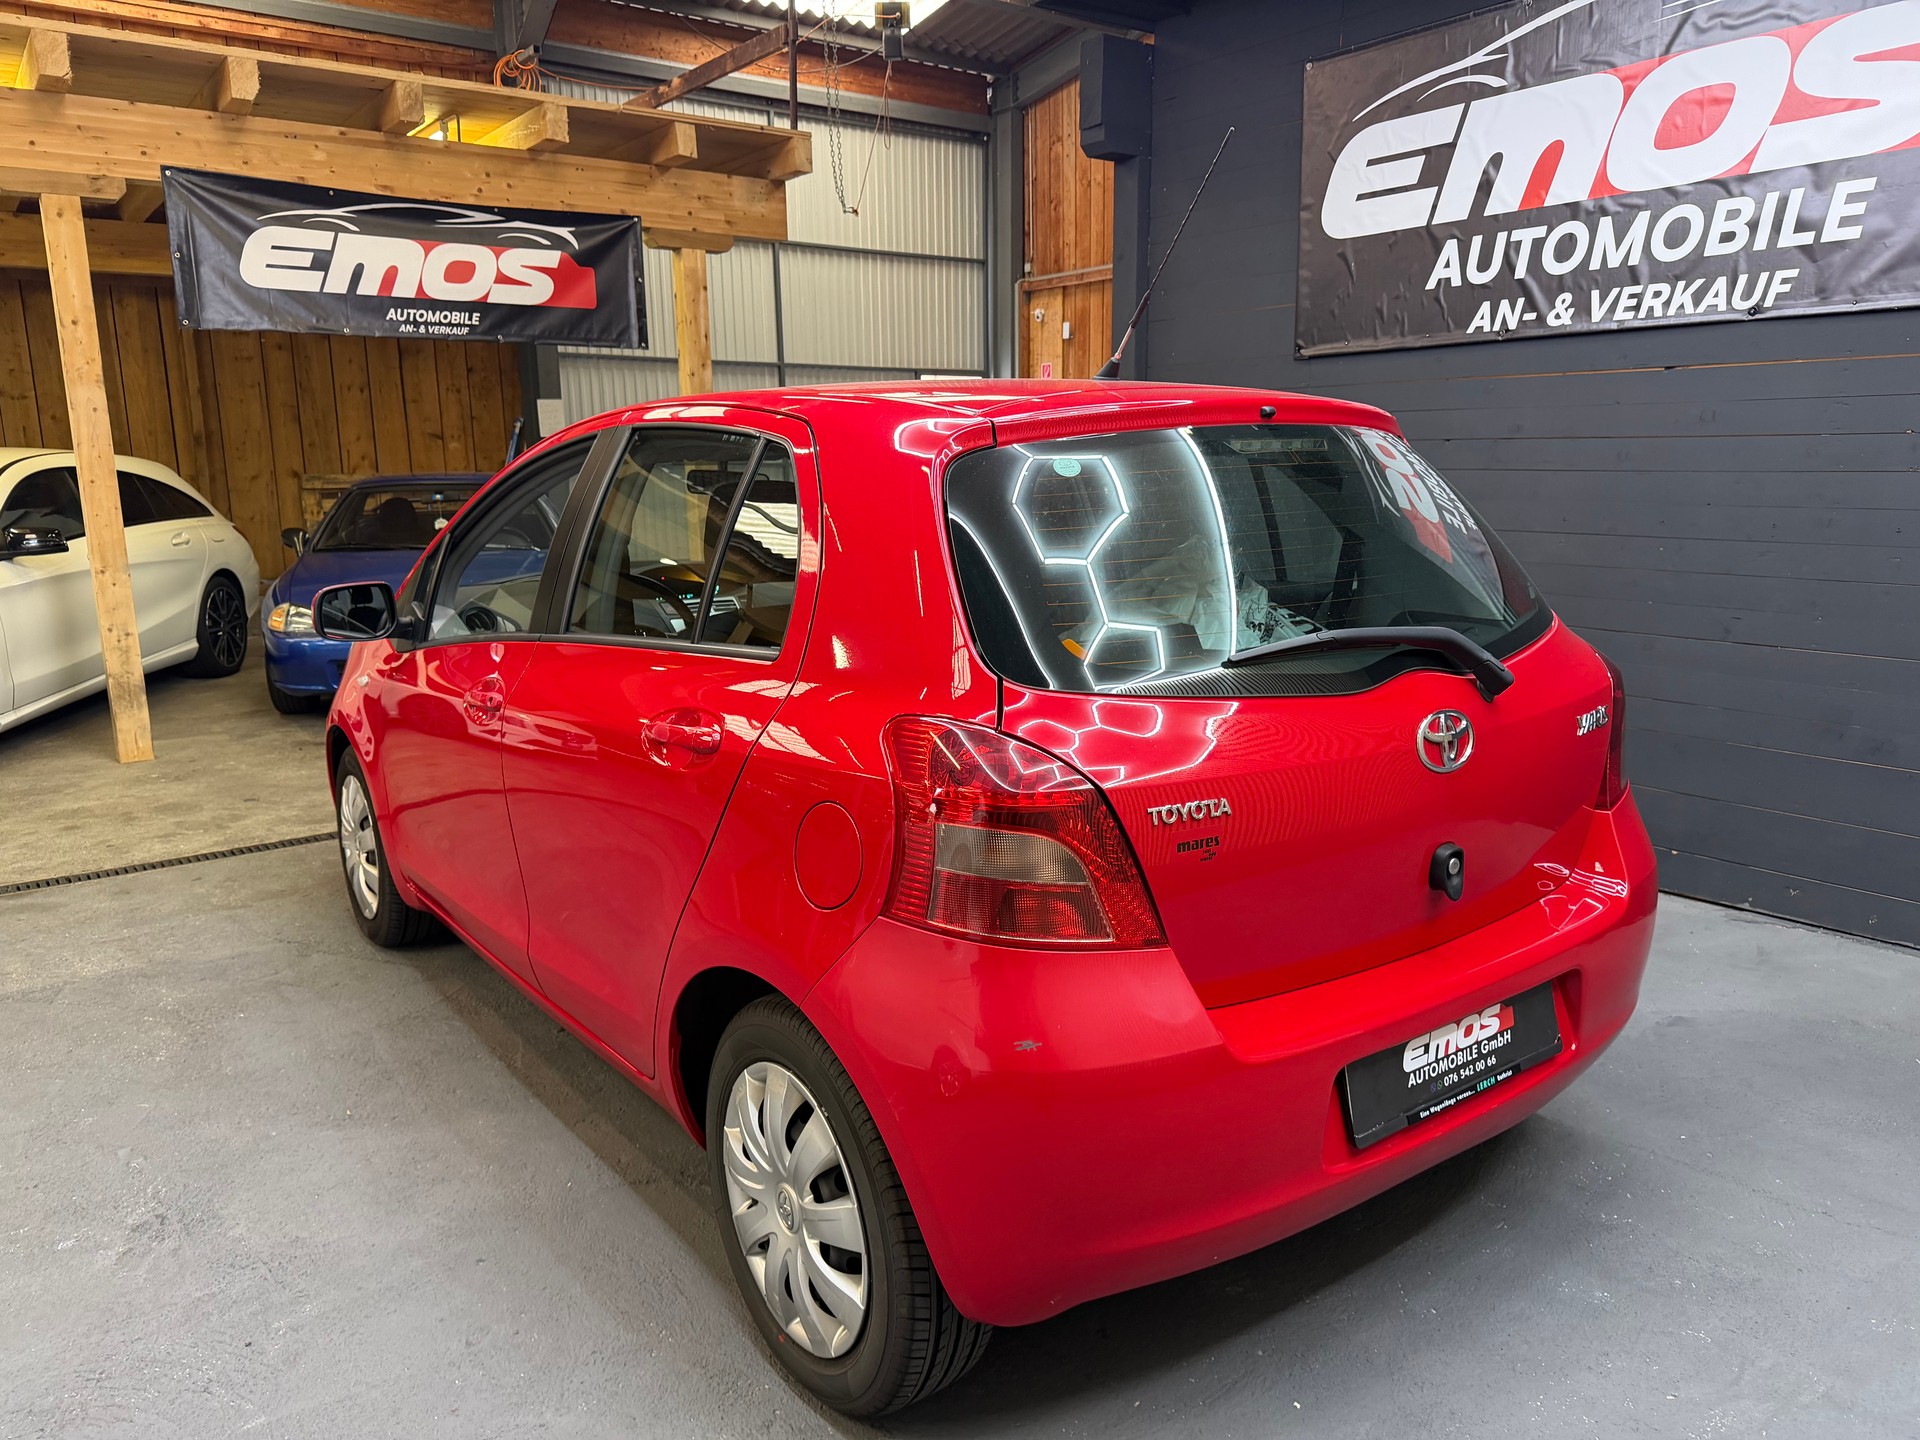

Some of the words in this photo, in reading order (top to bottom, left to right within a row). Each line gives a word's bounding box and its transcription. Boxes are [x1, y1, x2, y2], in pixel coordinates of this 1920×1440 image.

[1425, 177, 1877, 291] AUTOMOBILE
[239, 226, 562, 306] EMOS
[386, 308, 480, 325] AUTOMOBILE
[1466, 297, 1537, 334] AN-
[1545, 292, 1574, 327] &
[1590, 269, 1799, 324] VERKAUF
[399, 324, 417, 333] AN-
[419, 325, 426, 334] &
[428, 325, 469, 335] VERKAUF
[1147, 798, 1232, 826] TOYOTA
[1177, 836, 1220, 853] mares
[1403, 1003, 1501, 1073] EMOS
[1408, 1044, 1478, 1088] AUTOMOBILE
[1481, 1030, 1511, 1054] GmbH
[1444, 1073, 1458, 1087] 076
[1460, 1065, 1475, 1079] 542
[1475, 1060, 1486, 1072] 00
[1487, 1055, 1497, 1067] 66
[1477, 1076, 1496, 1092] LERCH
